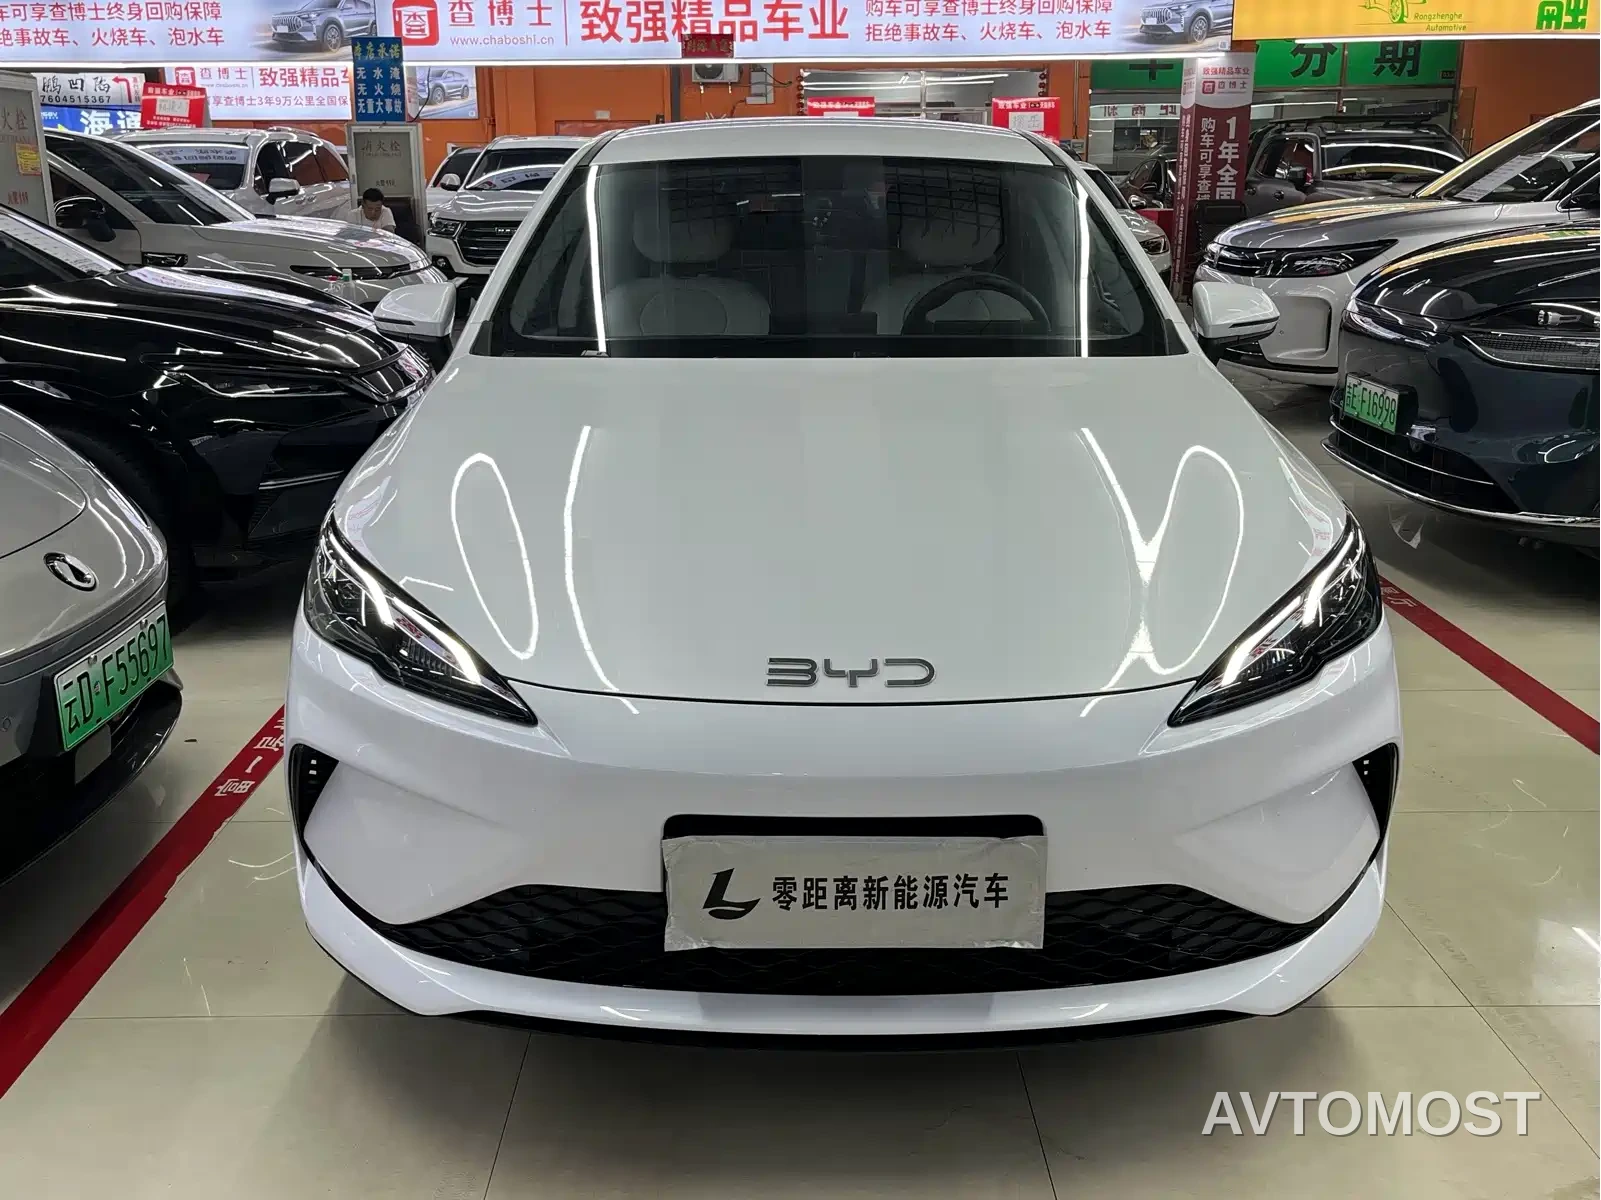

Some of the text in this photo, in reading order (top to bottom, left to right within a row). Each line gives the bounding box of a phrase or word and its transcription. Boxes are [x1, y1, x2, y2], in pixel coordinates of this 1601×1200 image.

[865, 0, 1113, 17] 购车可享查博士终身回购保障
[865, 20, 1112, 41] 拒绝事故车、火烧车、泡水车
[1425, 23, 1467, 32] Automotive
[449, 35, 555, 46] www.chaboshi.cn
[765, 656, 936, 688] BYD
[772, 873, 1010, 911] 零距离新能源汽车
